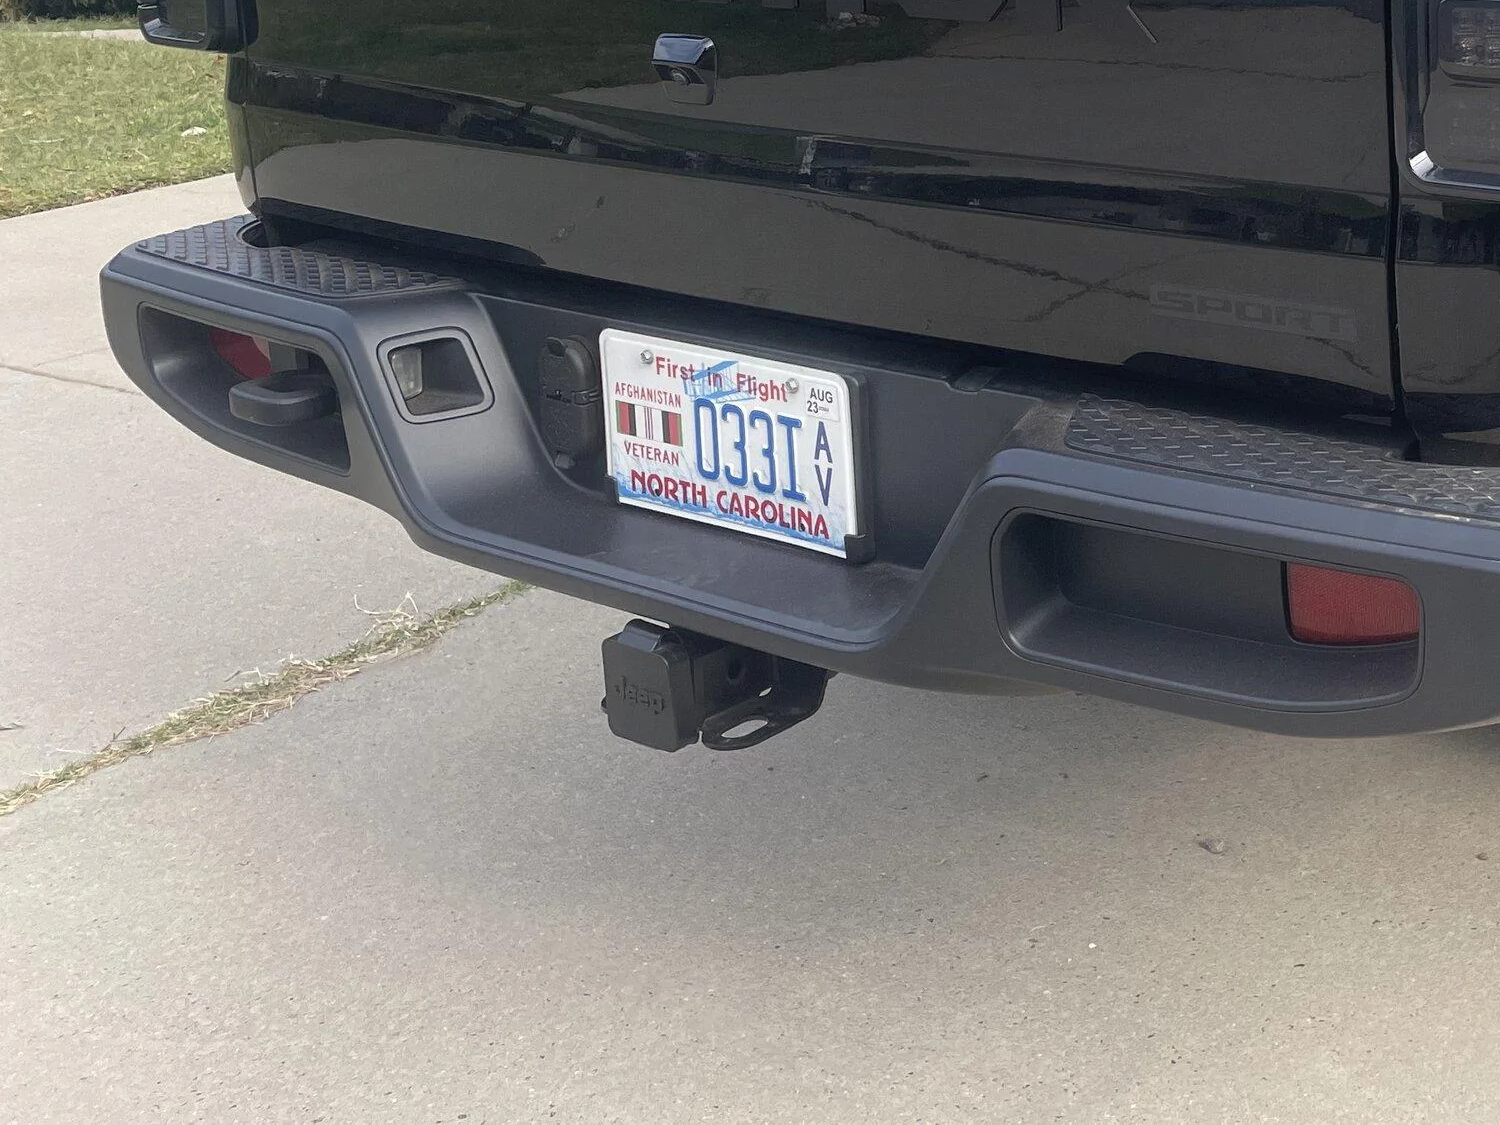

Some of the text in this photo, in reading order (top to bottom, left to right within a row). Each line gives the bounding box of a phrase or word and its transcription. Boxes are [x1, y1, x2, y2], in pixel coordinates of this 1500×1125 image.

[1150, 282, 1358, 341] SPORT
[614, 381, 682, 408] AFGHANISTAN
[655, 356, 789, 403] First in Flight
[810, 387, 833, 404] AUG
[807, 400, 819, 414] 23
[624, 440, 680, 467] VETERAN
[631, 469, 830, 540] NORTH CAROLINA
[613, 676, 666, 715] Jeep
